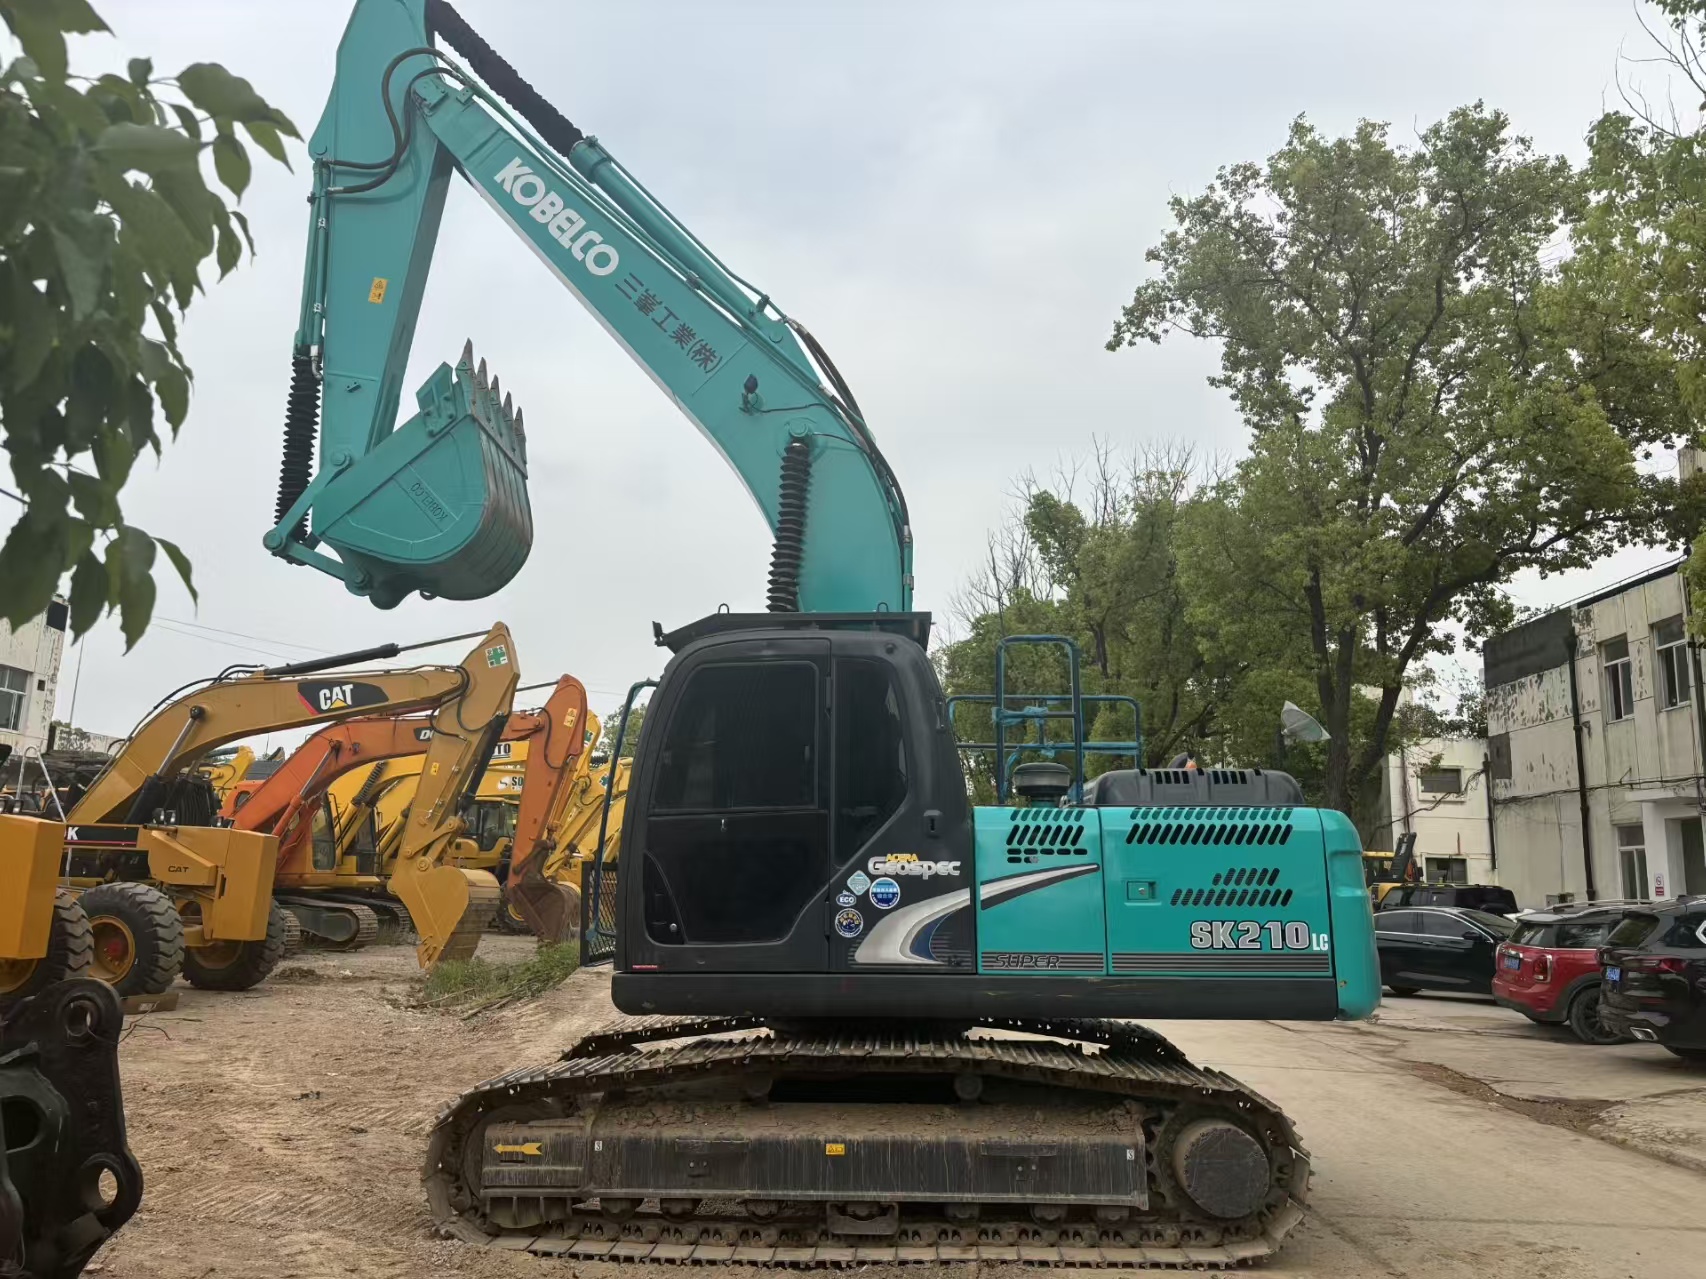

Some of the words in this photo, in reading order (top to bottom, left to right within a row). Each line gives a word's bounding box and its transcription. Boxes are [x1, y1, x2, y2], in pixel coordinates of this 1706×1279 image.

[494, 156, 620, 276] KOBELCO
[410, 482, 449, 522] KOBELCO
[319, 683, 354, 711] CAT
[496, 743, 511, 755] TO
[511, 776, 524, 786] SO
[64, 826, 80, 841] K
[886, 853, 919, 863] ACERA
[168, 865, 190, 874] CAT
[1190, 920, 1311, 950] SK210
[1312, 933, 1329, 951] LC
[994, 953, 1062, 969] SUPER
